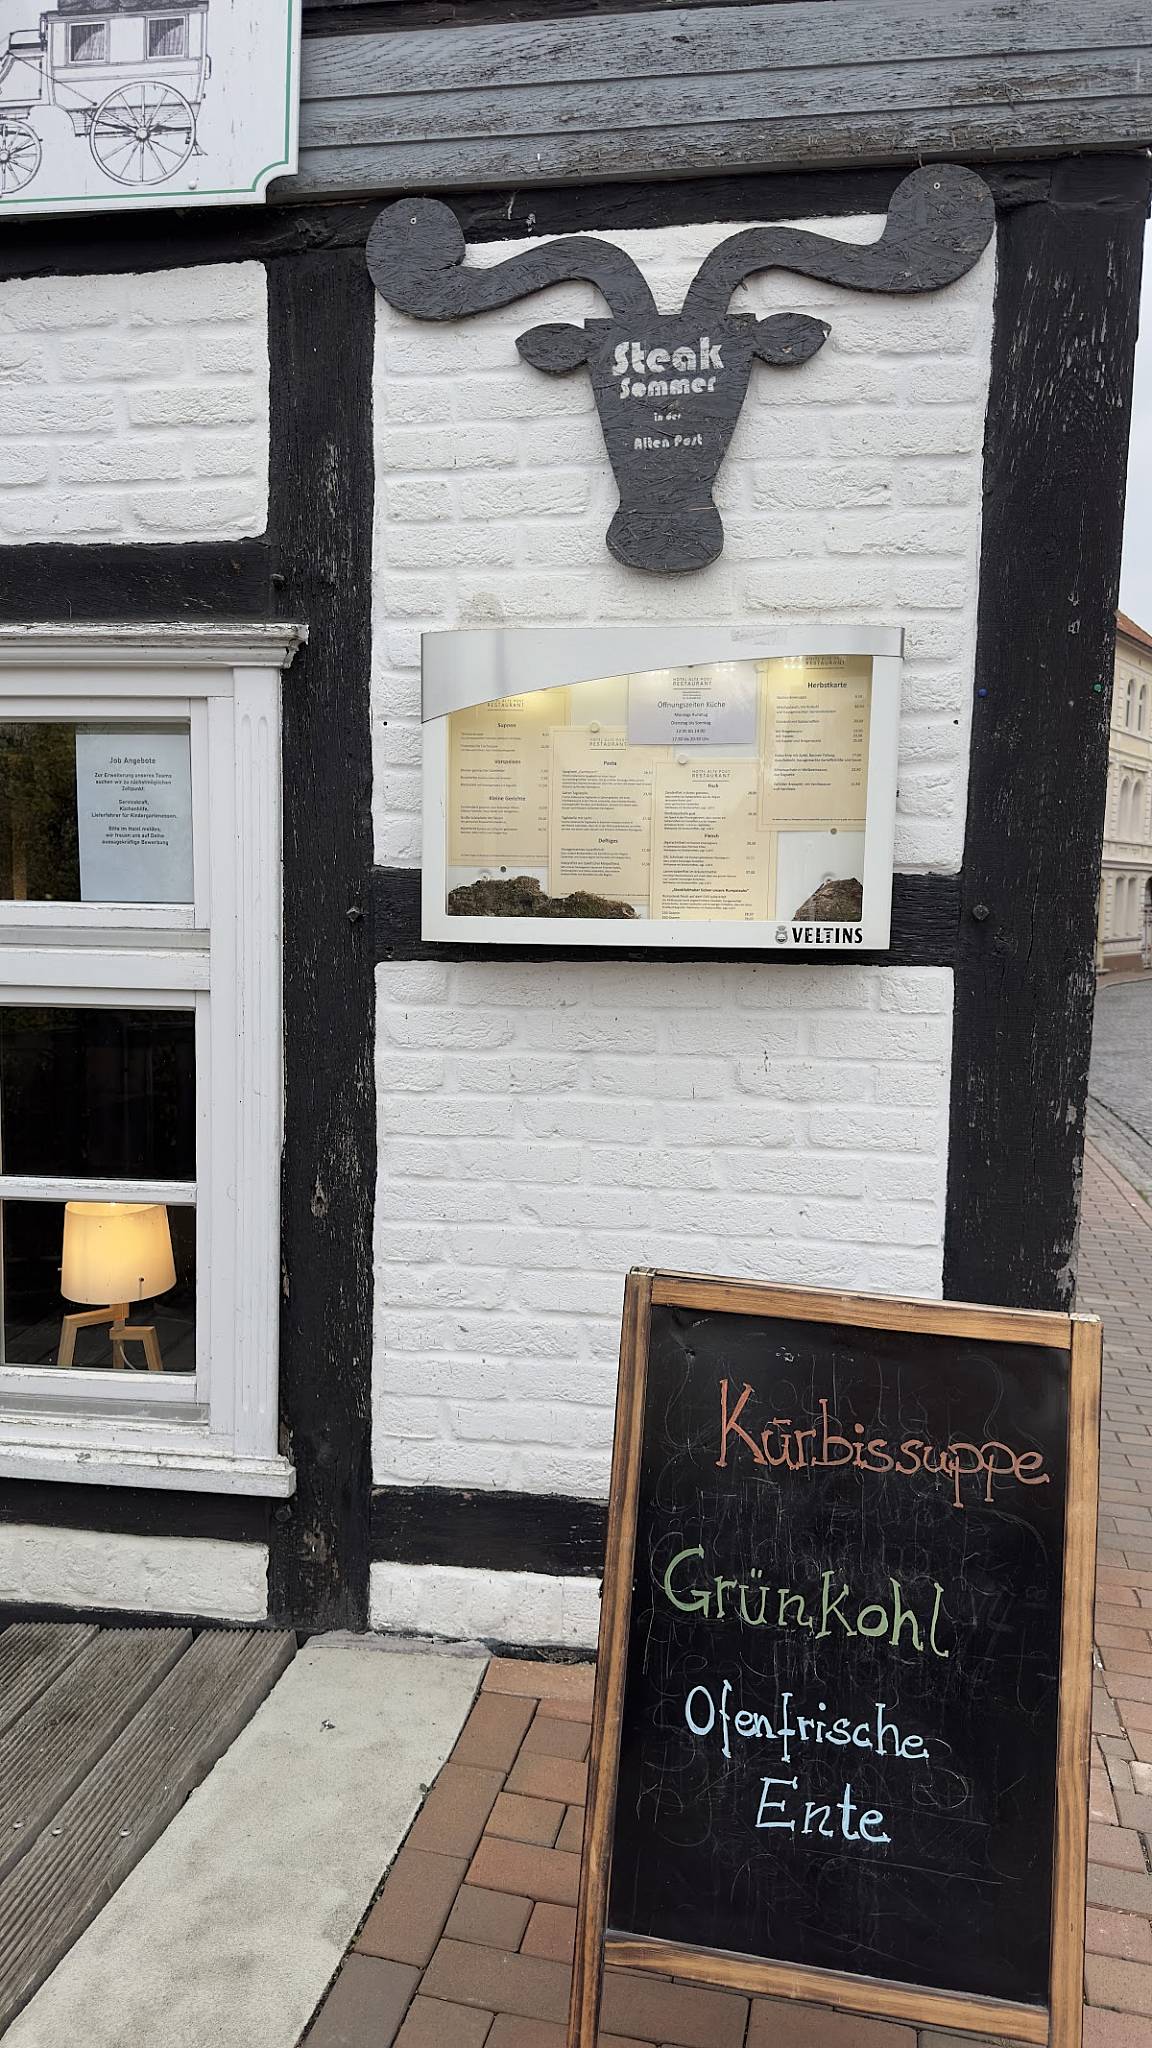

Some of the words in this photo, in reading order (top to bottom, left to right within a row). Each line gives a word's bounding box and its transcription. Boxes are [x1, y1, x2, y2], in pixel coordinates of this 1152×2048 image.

[612, 336, 725, 376] Steak
[620, 376, 717, 399] Sommer
[653, 412, 663, 421] in
[665, 411, 681, 421] der
[634, 437, 670, 450] Alten
[674, 433, 703, 447] Post
[657, 700, 705, 709] Öffnungszeiten
[123, 757, 156, 765] Angebote
[791, 927, 863, 944] VELTINS
[664, 1544, 949, 1658] Grünkohl
[685, 1680, 930, 1763] Ofenfrische
[755, 1776, 892, 1843] Ente
